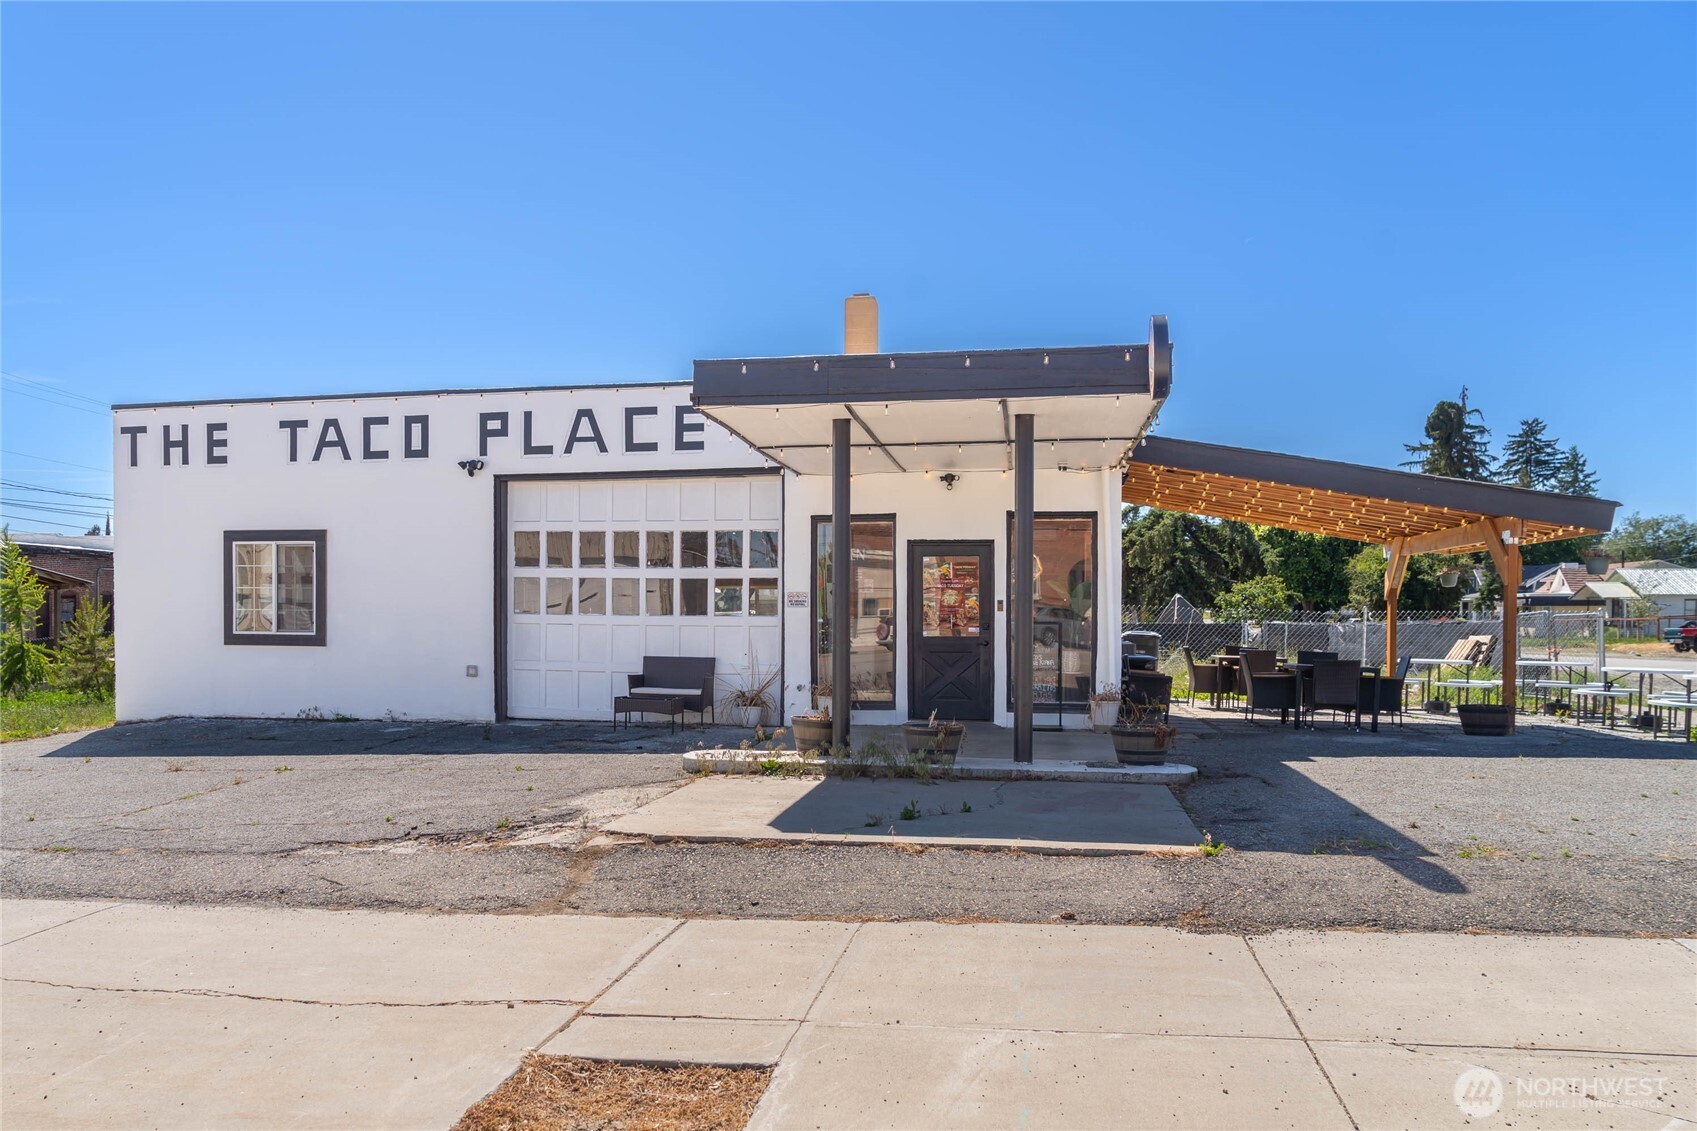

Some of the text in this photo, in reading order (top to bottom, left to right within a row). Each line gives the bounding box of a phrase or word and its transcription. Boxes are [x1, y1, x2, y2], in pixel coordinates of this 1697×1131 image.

[120, 405, 705, 467] THE TACO PLACE
